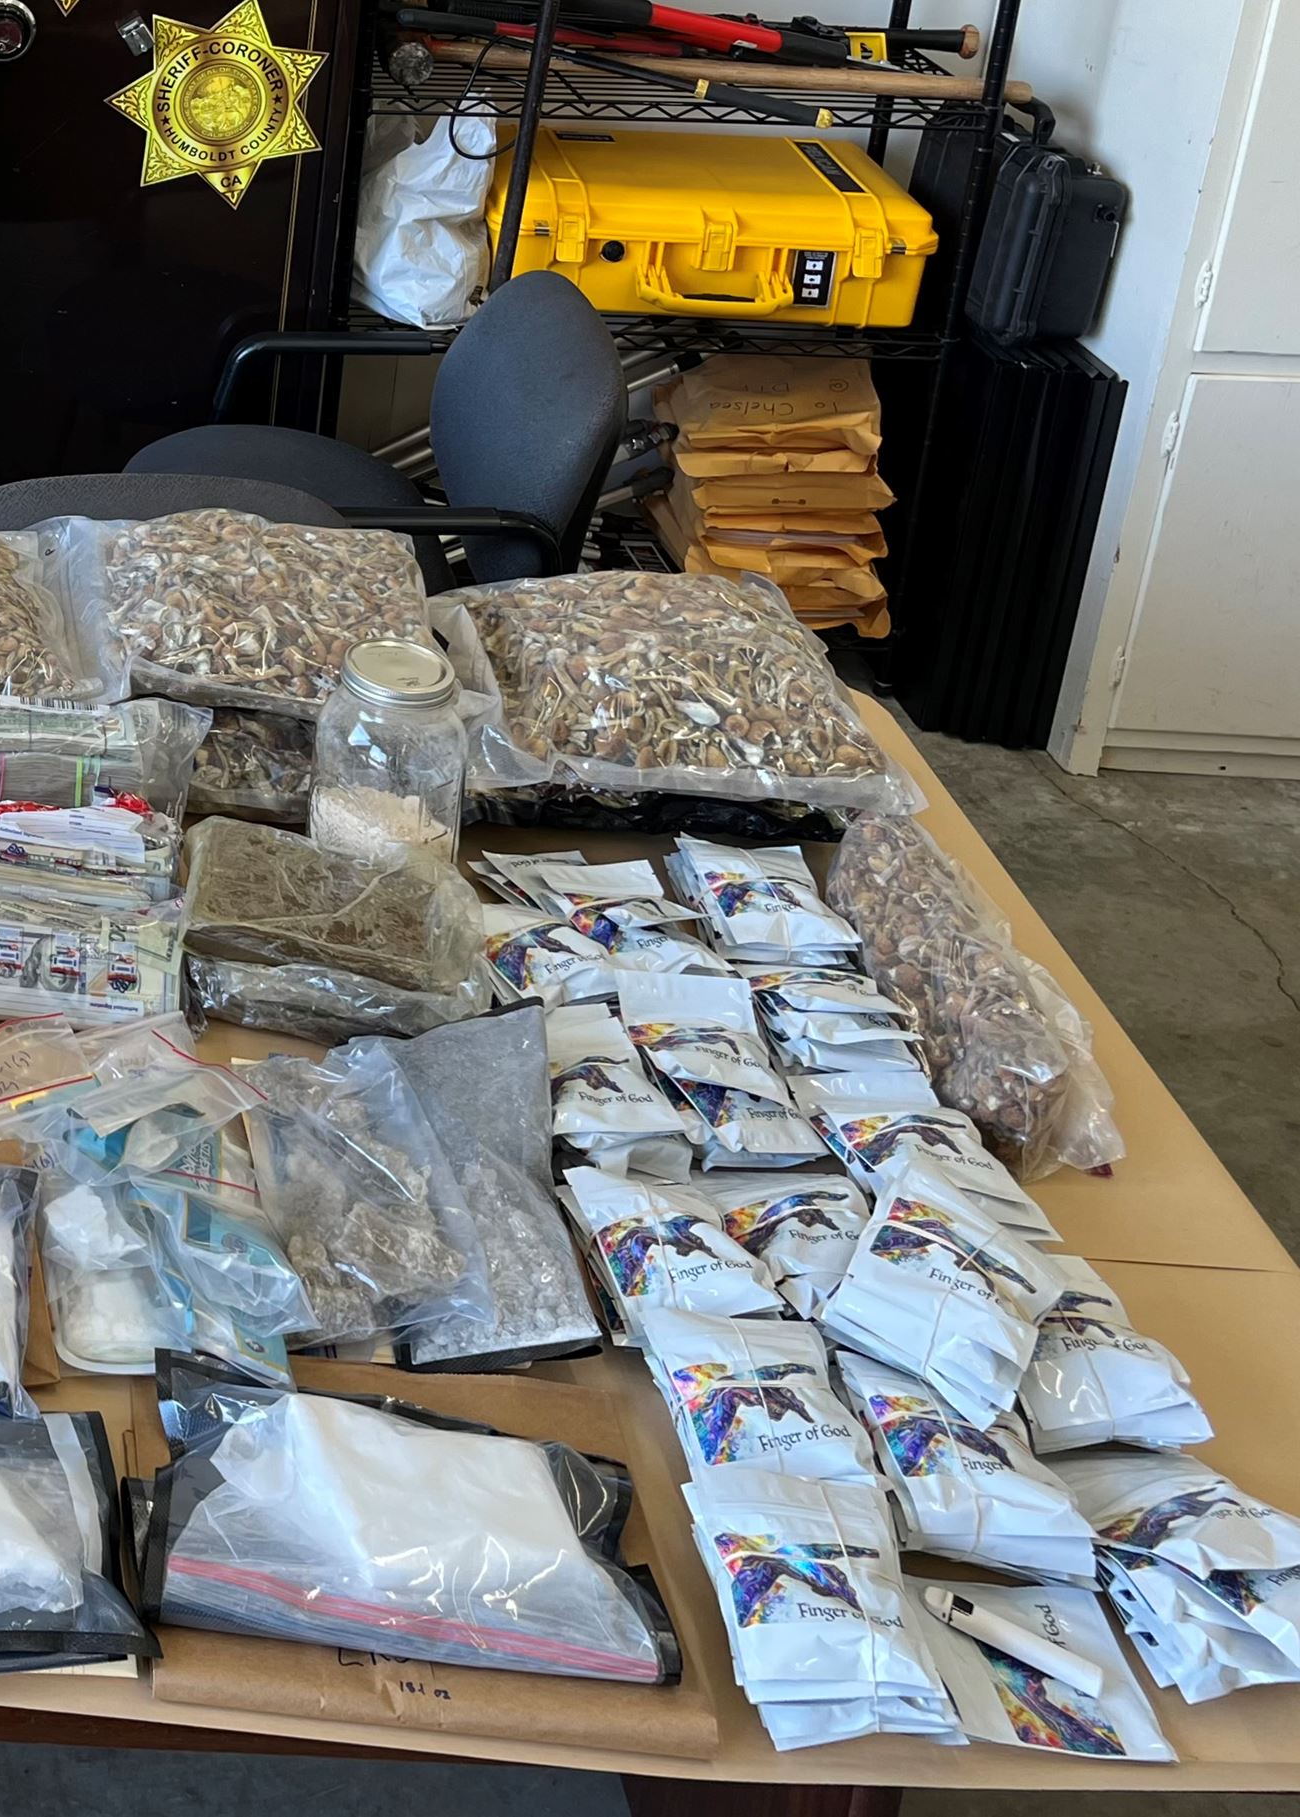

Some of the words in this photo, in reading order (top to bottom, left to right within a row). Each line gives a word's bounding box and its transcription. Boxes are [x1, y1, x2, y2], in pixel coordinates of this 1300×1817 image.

[157, 41, 283, 112] SHERIFF-CORONER
[164, 126, 236, 162] HUMBOLDT
[241, 107, 282, 155] COUNTY
[220, 174, 243, 188] CA
[709, 401, 794, 417] Chelsea
[637, 935, 671, 947] Finger
[730, 1056, 742, 1066] of
[616, 1095, 628, 1103] of
[629, 1093, 655, 1103] God
[953, 1155, 966, 1164] of
[967, 1156, 994, 1171] God
[789, 1229, 828, 1243] Finger
[830, 1231, 844, 1242] of
[671, 1261, 708, 1283] Finger
[710, 1257, 723, 1271] of
[725, 1259, 753, 1269] God
[929, 1267, 976, 1291] Finger
[977, 1288, 997, 1300] of
[758, 1431, 801, 1452] Finger
[805, 1425, 821, 1440] of
[820, 1424, 850, 1438] God
[962, 1456, 1006, 1475] Finger
[1235, 1508, 1249, 1519] of
[797, 1602, 848, 1622] Finger
[1034, 1604, 1060, 1637] God
